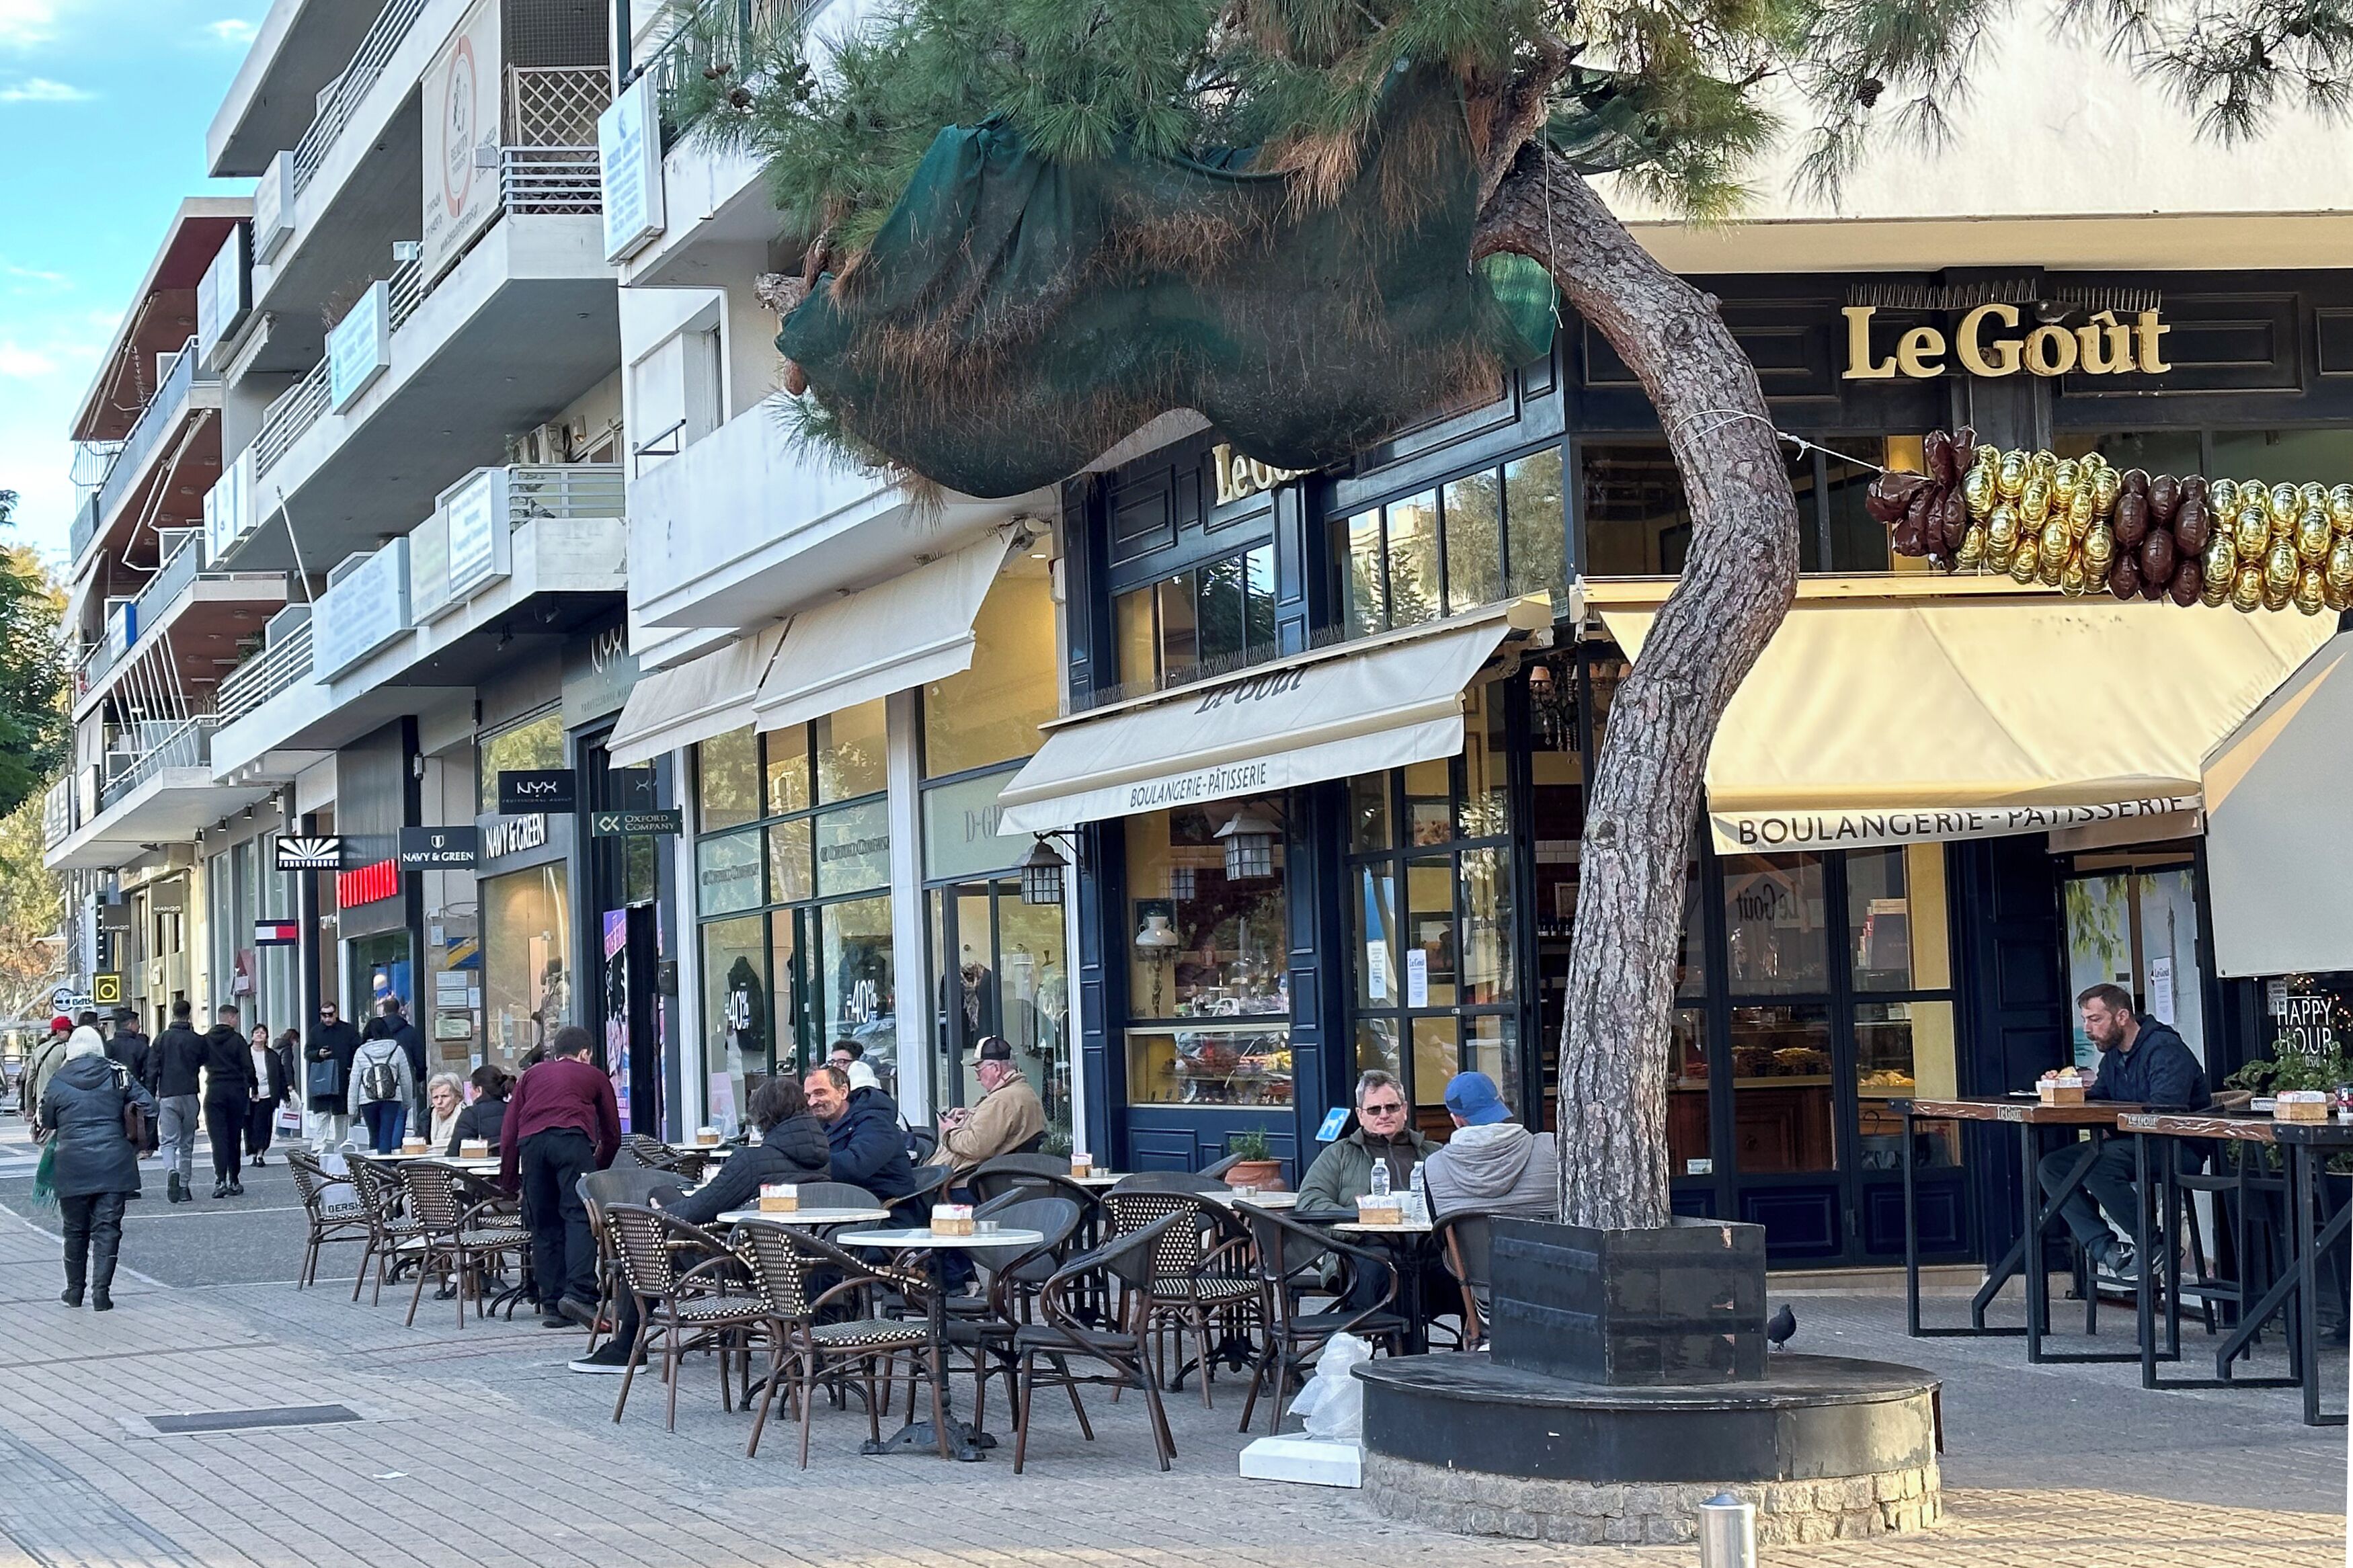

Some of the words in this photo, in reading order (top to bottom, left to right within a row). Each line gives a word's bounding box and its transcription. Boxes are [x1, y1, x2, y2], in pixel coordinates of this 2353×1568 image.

[591, 624, 624, 677] NYX
[517, 781, 557, 794] NYX
[625, 815, 668, 823] OXFORD
[625, 823, 674, 831] COMPANY
[485, 823, 508, 859] NAVY
[509, 823, 516, 852] &
[516, 813, 545, 851] GREEN
[403, 852, 429, 863] NAVY
[431, 852, 440, 862] &
[441, 852, 474, 862] GREEN
[2277, 1000, 2332, 1026] HAPPY
[2278, 1027, 2334, 1056] HOUR
